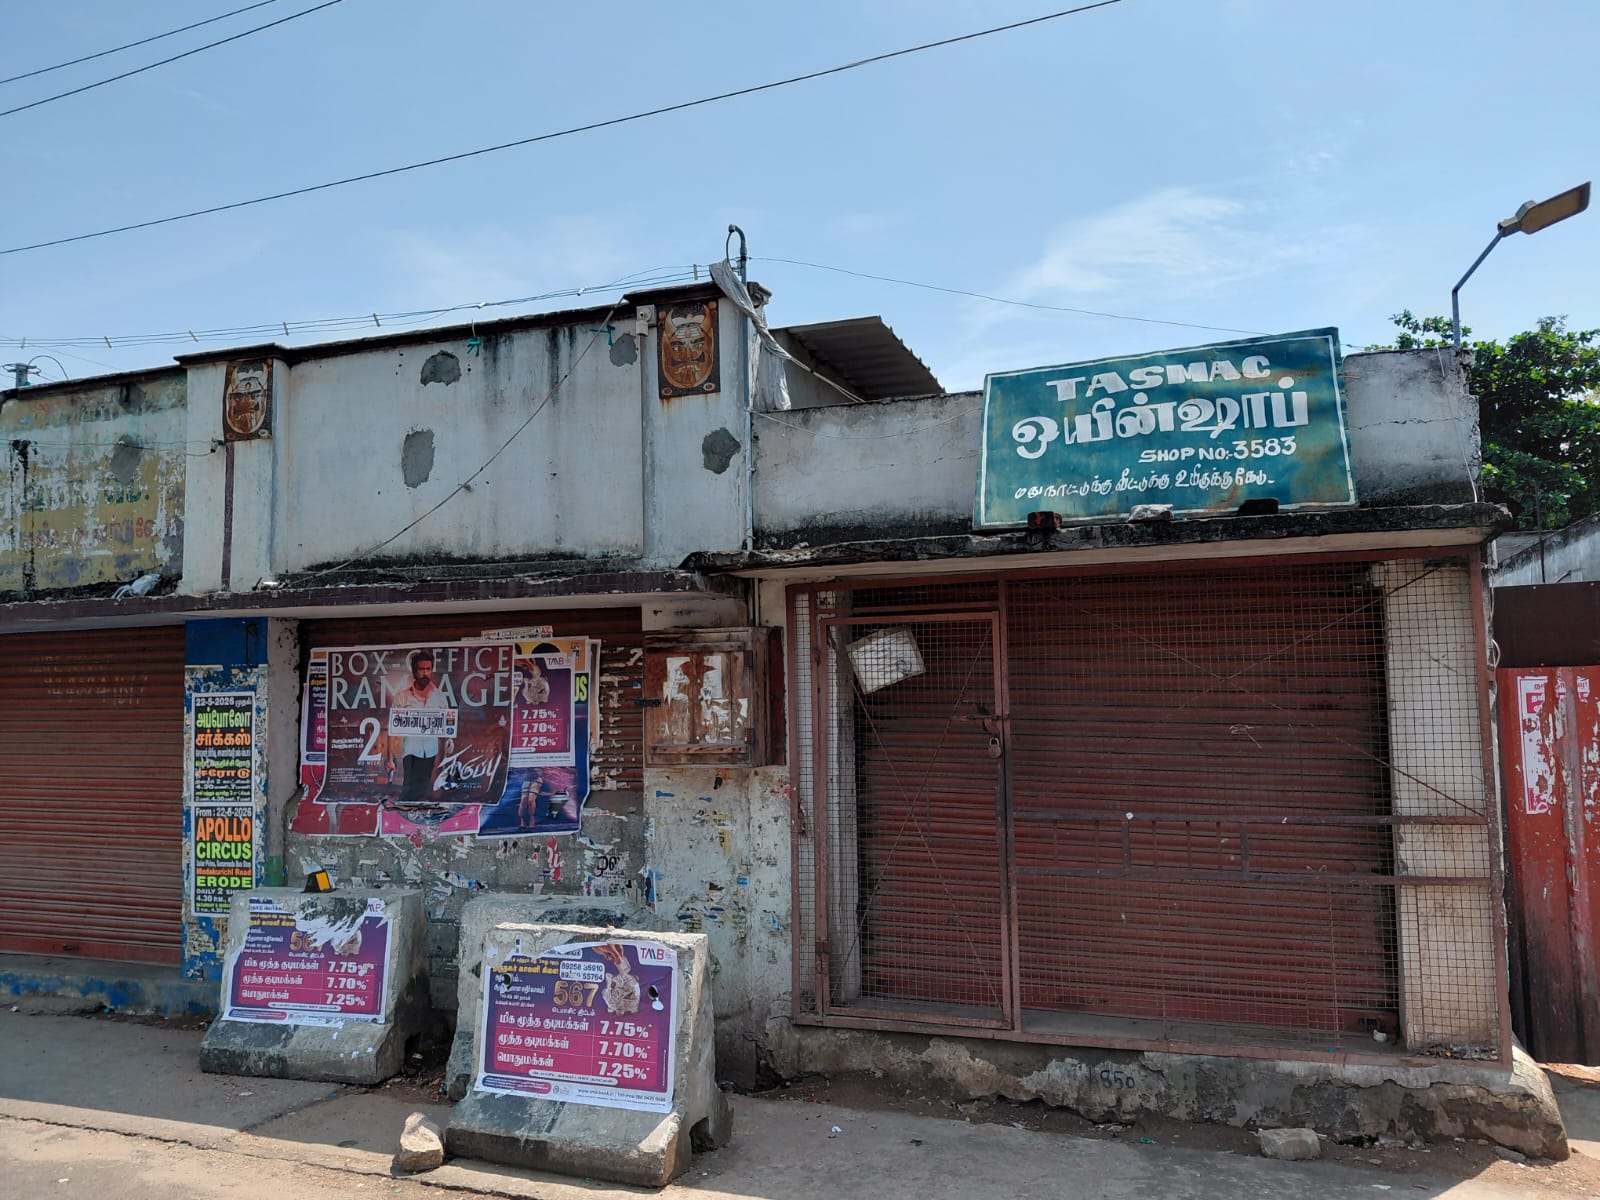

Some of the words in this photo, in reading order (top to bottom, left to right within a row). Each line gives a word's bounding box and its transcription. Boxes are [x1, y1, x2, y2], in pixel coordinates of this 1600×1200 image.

[1046, 355, 1271, 401] TASMAC
[1139, 448, 1196, 463] SHOP
[548, 657, 564, 665] TMB
[196, 706, 251, 728] அப்போலோ
[196, 728, 251, 746] சர்க்கஸ்
[358, 717, 382, 761] 2
[195, 807, 212, 817] From
[196, 817, 251, 841] APOLLO
[196, 842, 252, 859] CIRCUS
[196, 876, 252, 888] ERODE
[289, 931, 323, 952] 56
[640, 948, 664, 960] TMB
[244, 957, 257, 967] மிக
[259, 957, 280, 970] மூத்த
[281, 959, 319, 970] குடிமக்கள்
[243, 972, 264, 984] மூத்த
[265, 974, 303, 985] குடிமக்கள்
[242, 989, 289, 1000] பொதுமக்கள்
[553, 980, 599, 1007] 567
[499, 1011, 515, 1024] மிக
[517, 1013, 541, 1028] மூத்த
[543, 1016, 589, 1031] குடிமக்கள்
[498, 1030, 523, 1045] மூத்த
[524, 1034, 569, 1049] குடிமக்கள்
[497, 1052, 554, 1067] பொதுமக்கள்
[1100, 1070, 1136, 1089] 850
